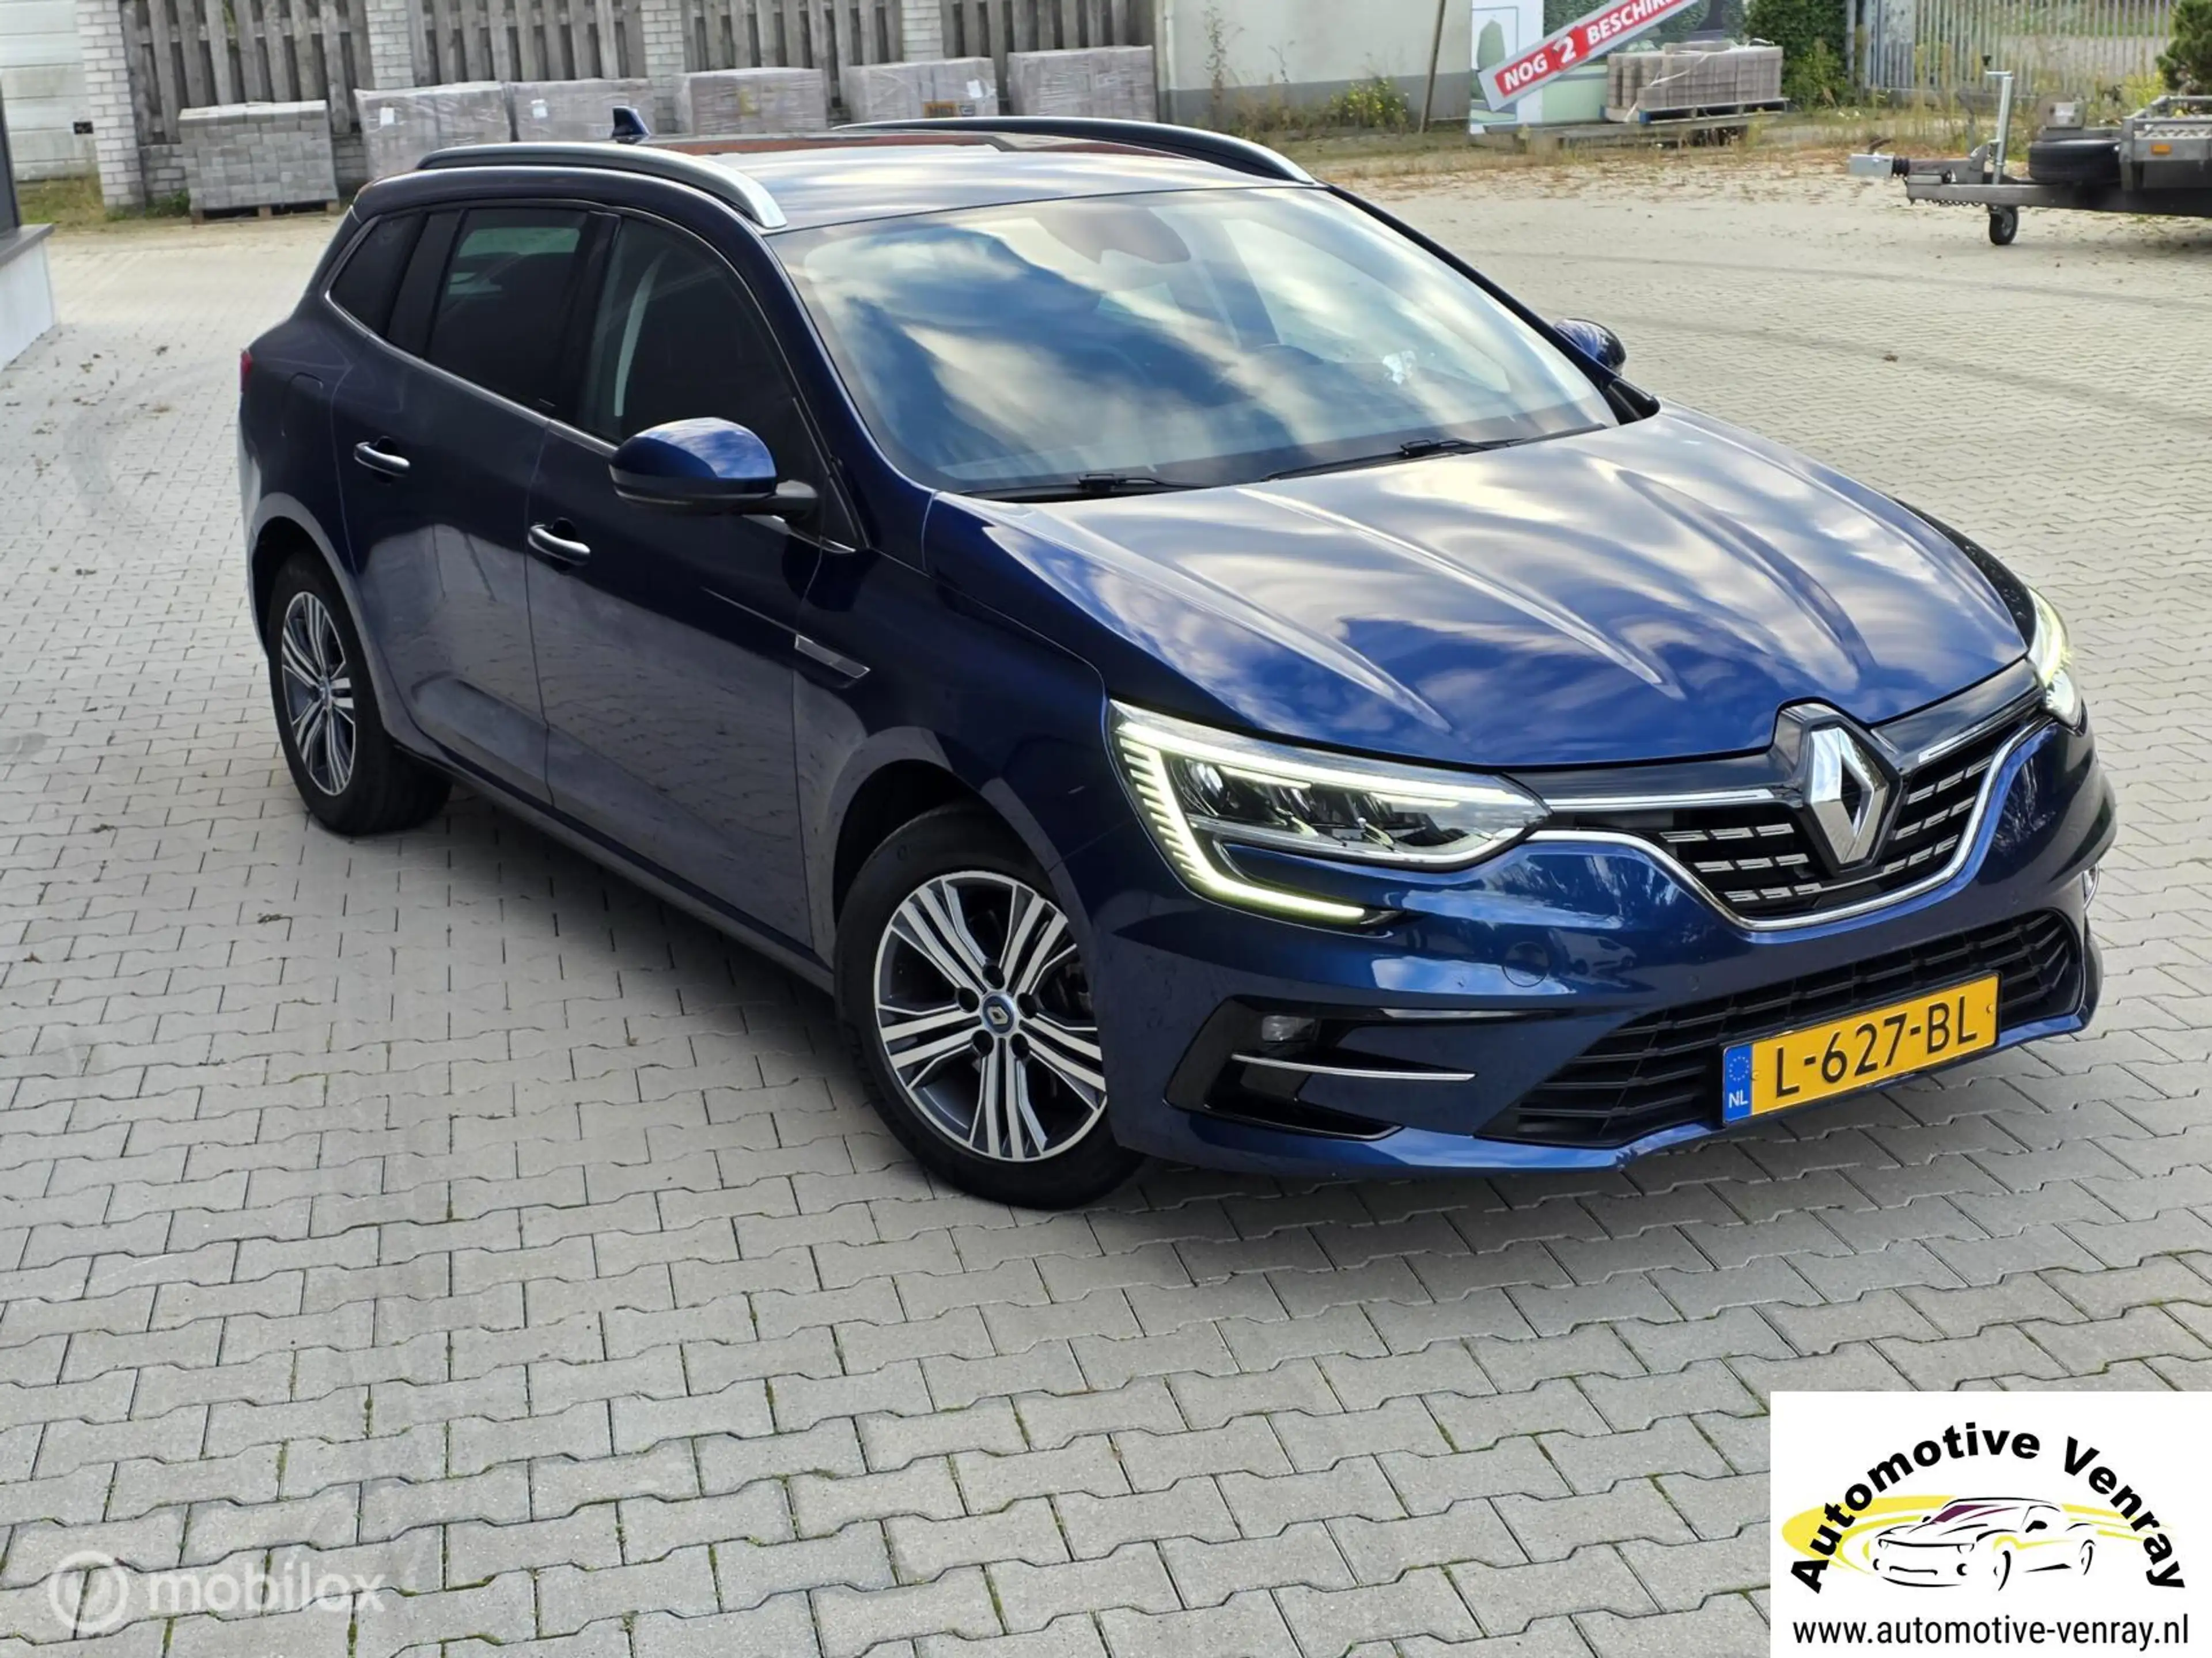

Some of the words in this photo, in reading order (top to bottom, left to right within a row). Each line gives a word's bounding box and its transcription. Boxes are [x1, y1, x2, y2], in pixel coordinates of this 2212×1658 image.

[1504, 52, 1548, 91] NOG
[1553, 36, 1577, 64] 2
[1586, 0, 1675, 45] BESCHI
[1776, 996, 1978, 1098] L-627-BL
[1728, 1090, 1748, 1109] NL
